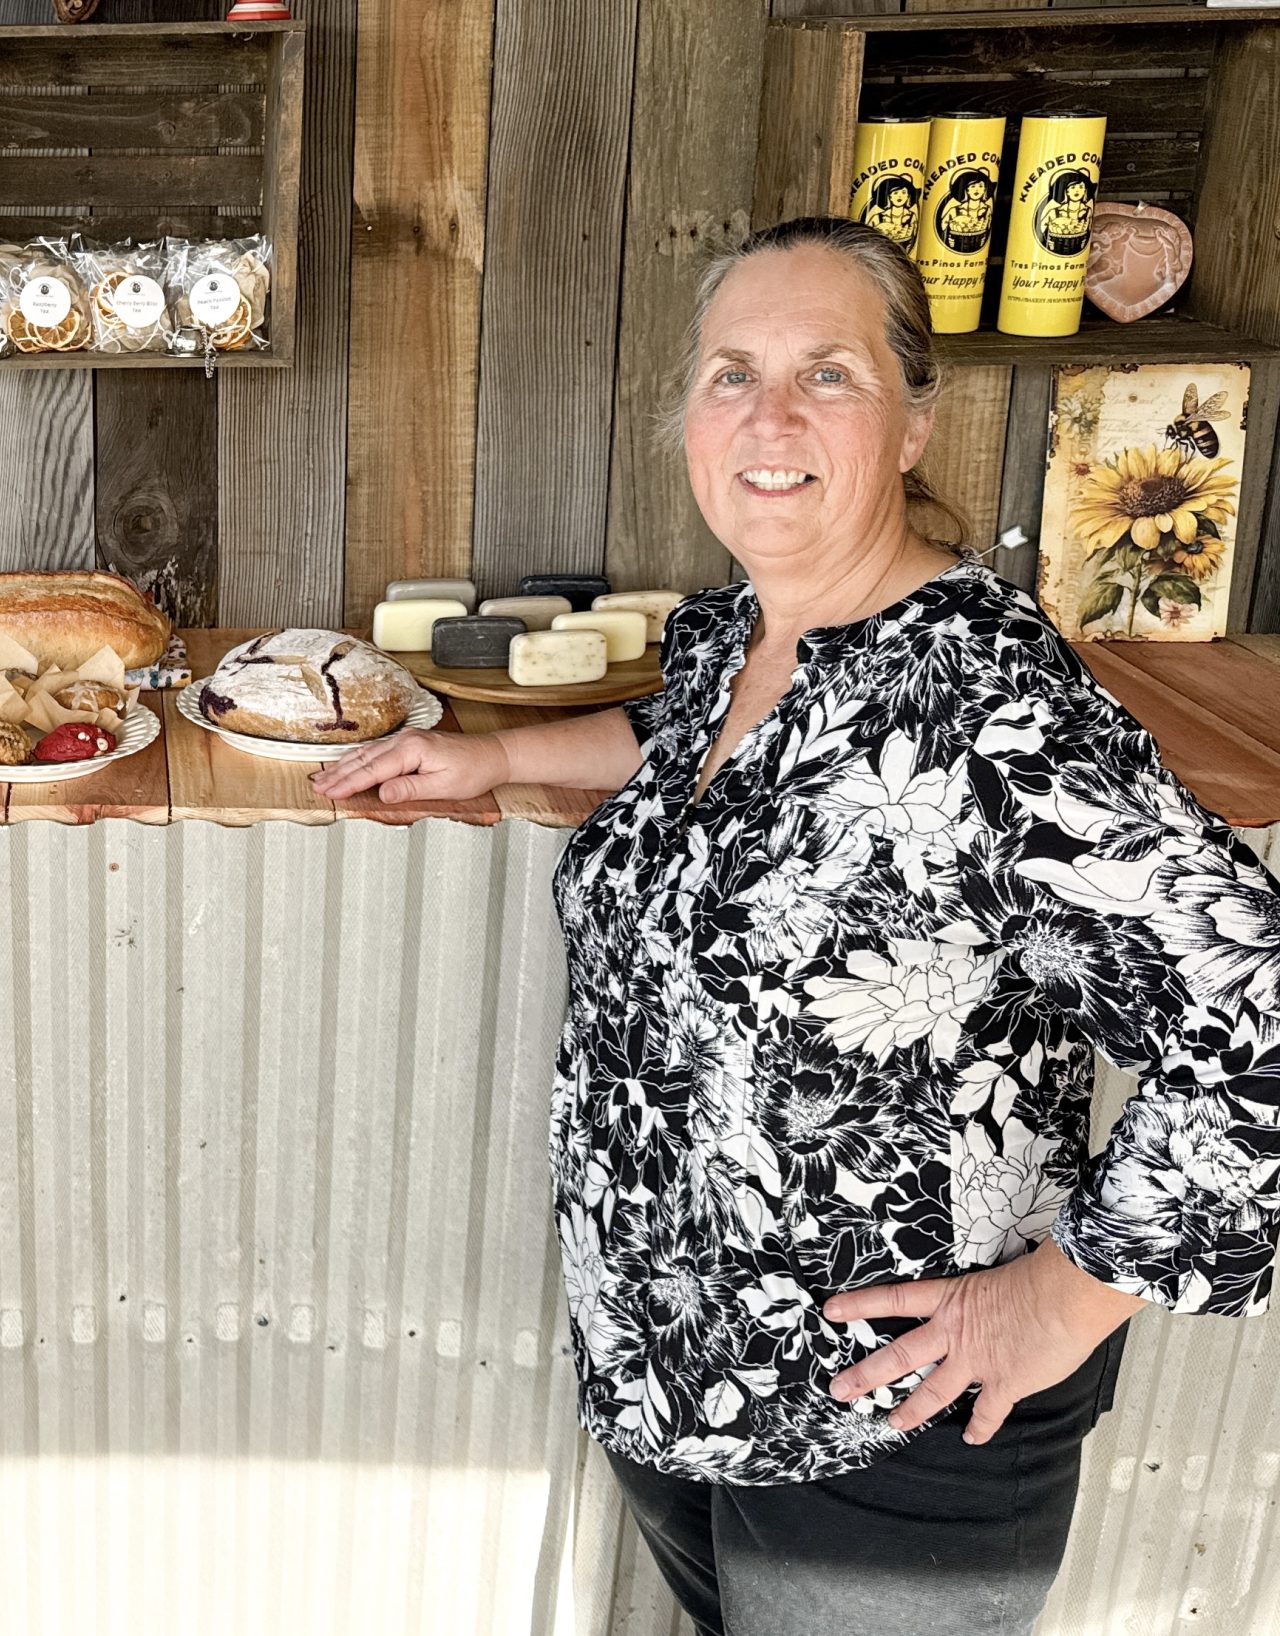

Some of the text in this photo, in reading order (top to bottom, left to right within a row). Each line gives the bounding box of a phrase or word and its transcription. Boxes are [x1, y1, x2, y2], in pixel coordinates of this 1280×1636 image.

[923, 152, 977, 200] KNEADED
[1019, 153, 1077, 203] KNEADED
[932, 259, 961, 268] Pinos
[1010, 259, 1029, 270] Tres
[1031, 262, 1062, 271] Pinos
[920, 275, 940, 284] our
[942, 274, 978, 289] Happy
[1012, 275, 1040, 291] Your
[1041, 277, 1080, 293] Happy
